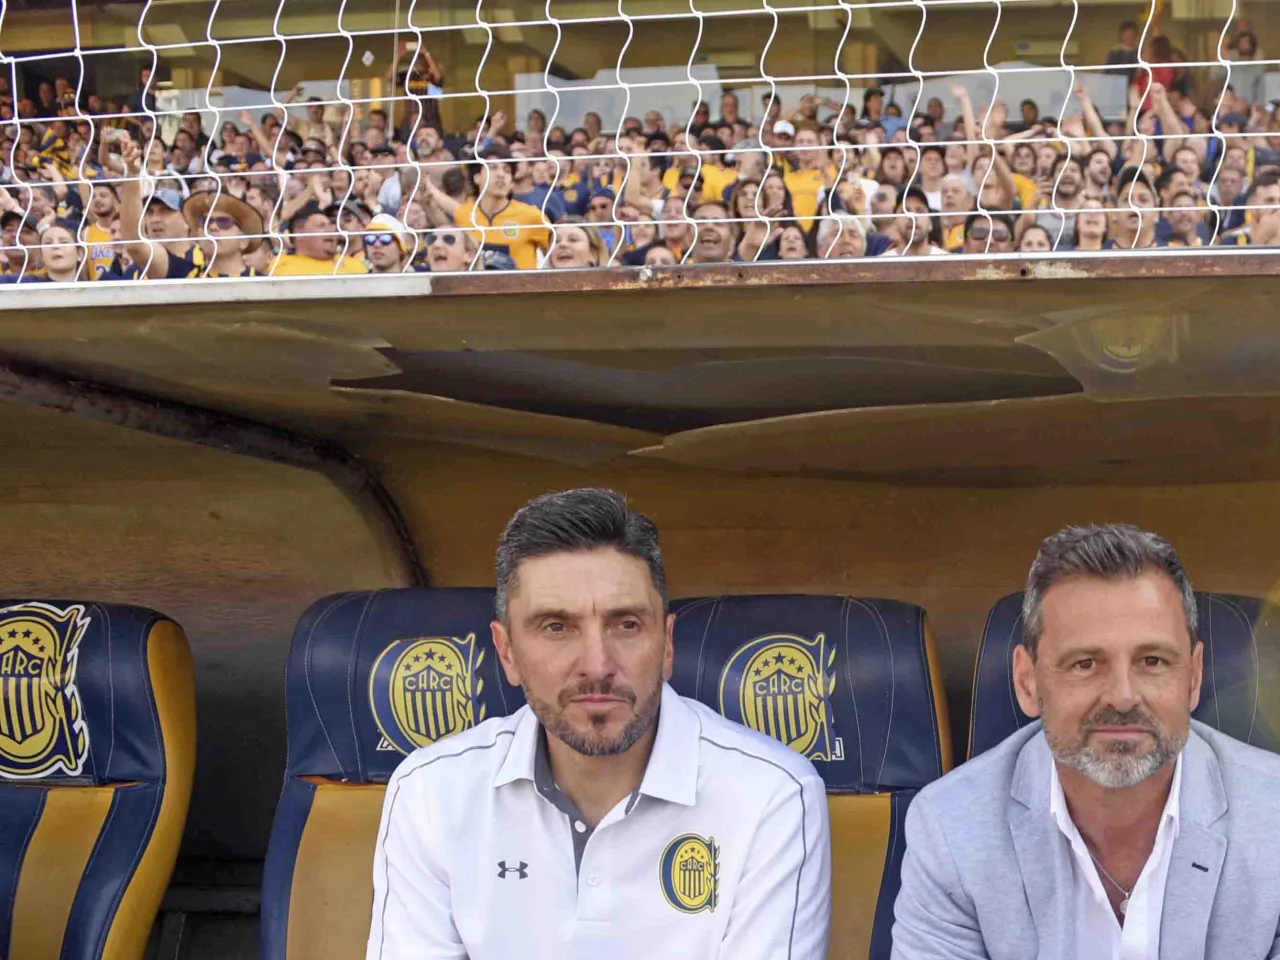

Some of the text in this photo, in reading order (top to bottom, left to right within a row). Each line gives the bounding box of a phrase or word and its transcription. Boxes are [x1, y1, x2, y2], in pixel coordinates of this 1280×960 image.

[0, 650, 42, 675] ARC
[405, 669, 451, 690] CARC
[755, 672, 802, 695] CARC
[680, 858, 704, 871] CARC
